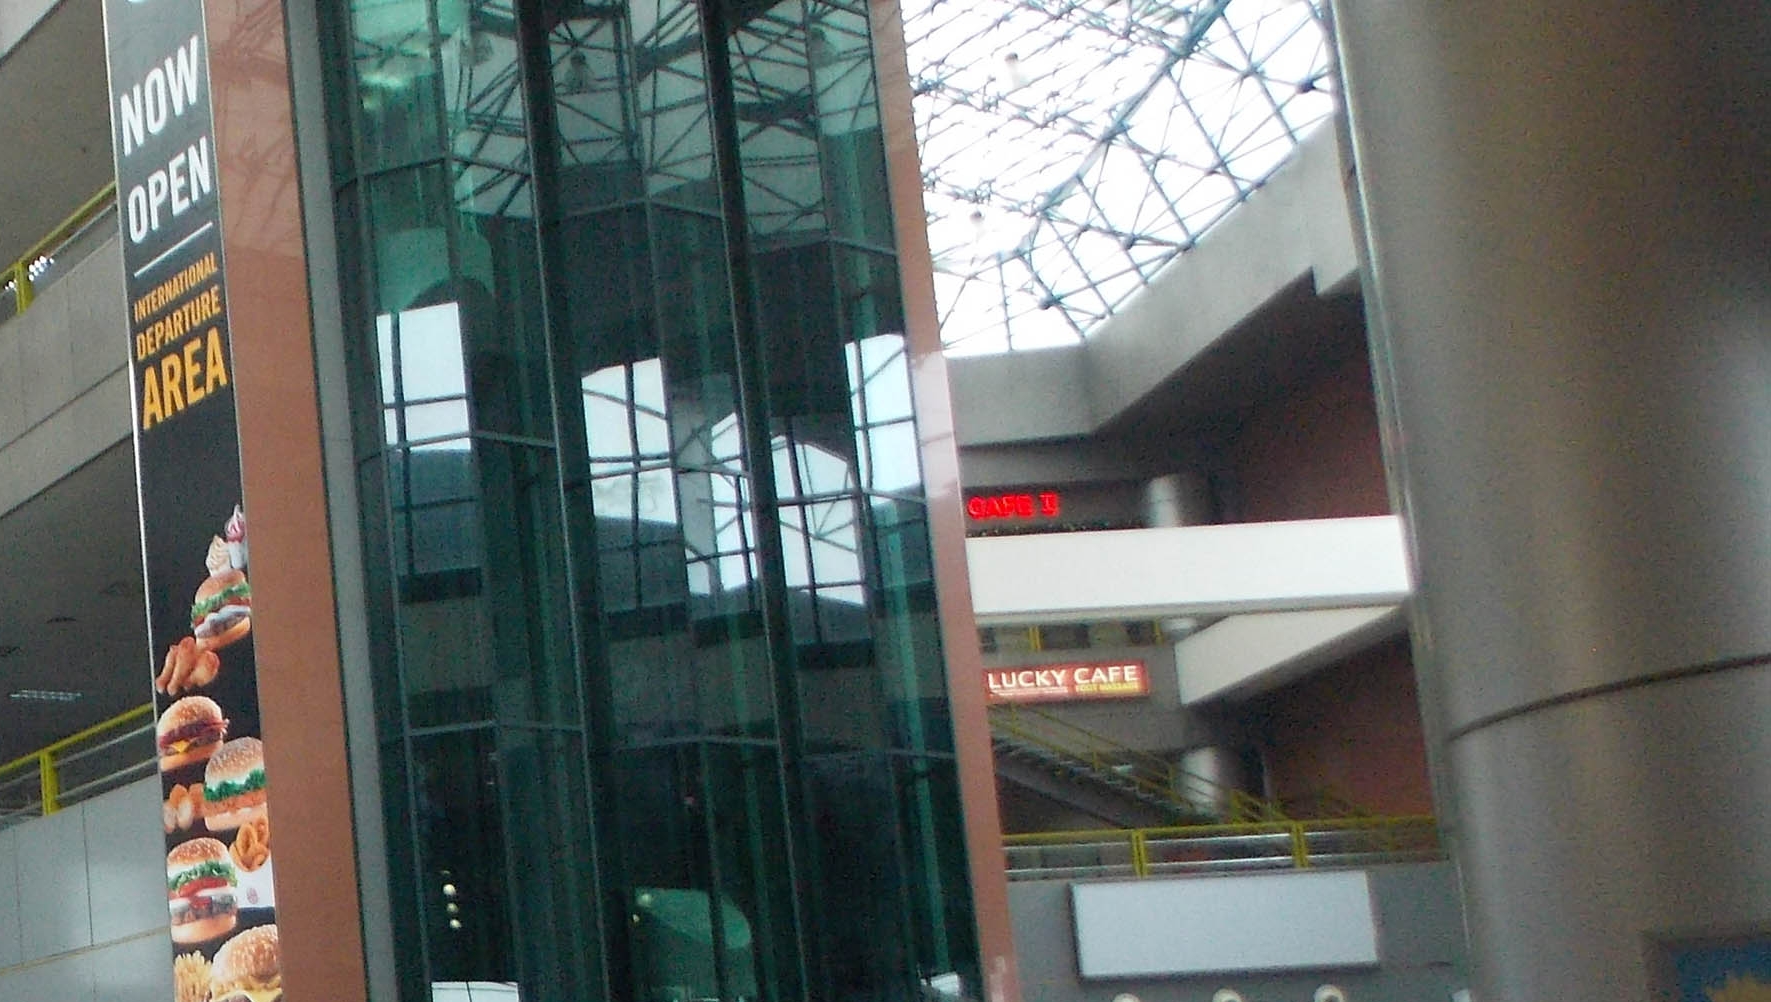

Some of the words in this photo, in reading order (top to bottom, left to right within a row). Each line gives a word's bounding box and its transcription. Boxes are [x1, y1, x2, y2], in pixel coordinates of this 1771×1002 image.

[119, 34, 200, 156] NOW
[127, 135, 211, 245] OPEN
[133, 251, 217, 323] INTERNATIONAL
[136, 284, 221, 359] DEPARTURE
[142, 326, 228, 430] AREA
[987, 669, 1067, 688] LUCKY
[1073, 665, 1141, 684] CAFE
